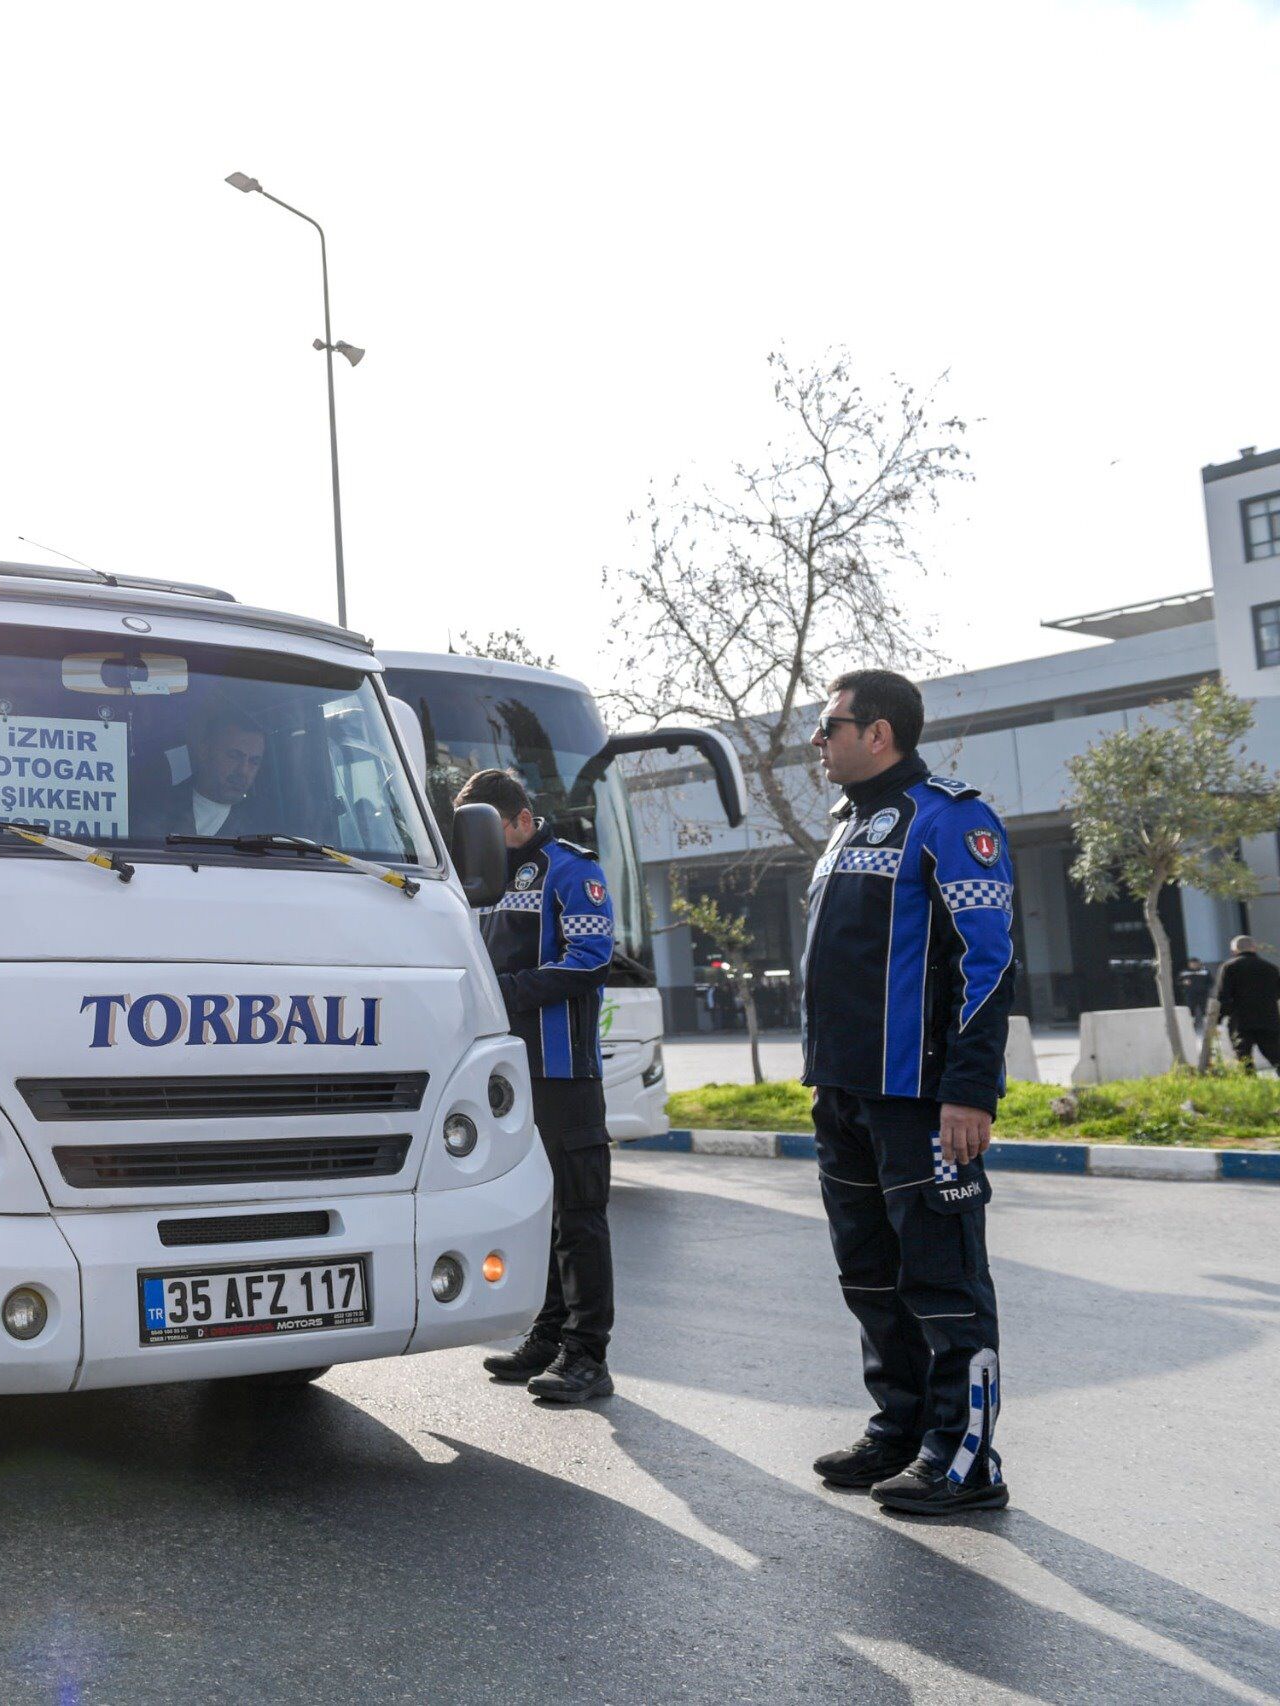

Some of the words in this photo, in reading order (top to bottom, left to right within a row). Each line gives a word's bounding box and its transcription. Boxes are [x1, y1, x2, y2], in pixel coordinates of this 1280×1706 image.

[79, 993, 382, 1048] TORBALI
[168, 1280, 212, 1323] 35
[225, 1273, 288, 1319] AFZ
[300, 1268, 356, 1311] 117
[148, 1308, 164, 1320] TR
[276, 1318, 324, 1331] MOTORS
